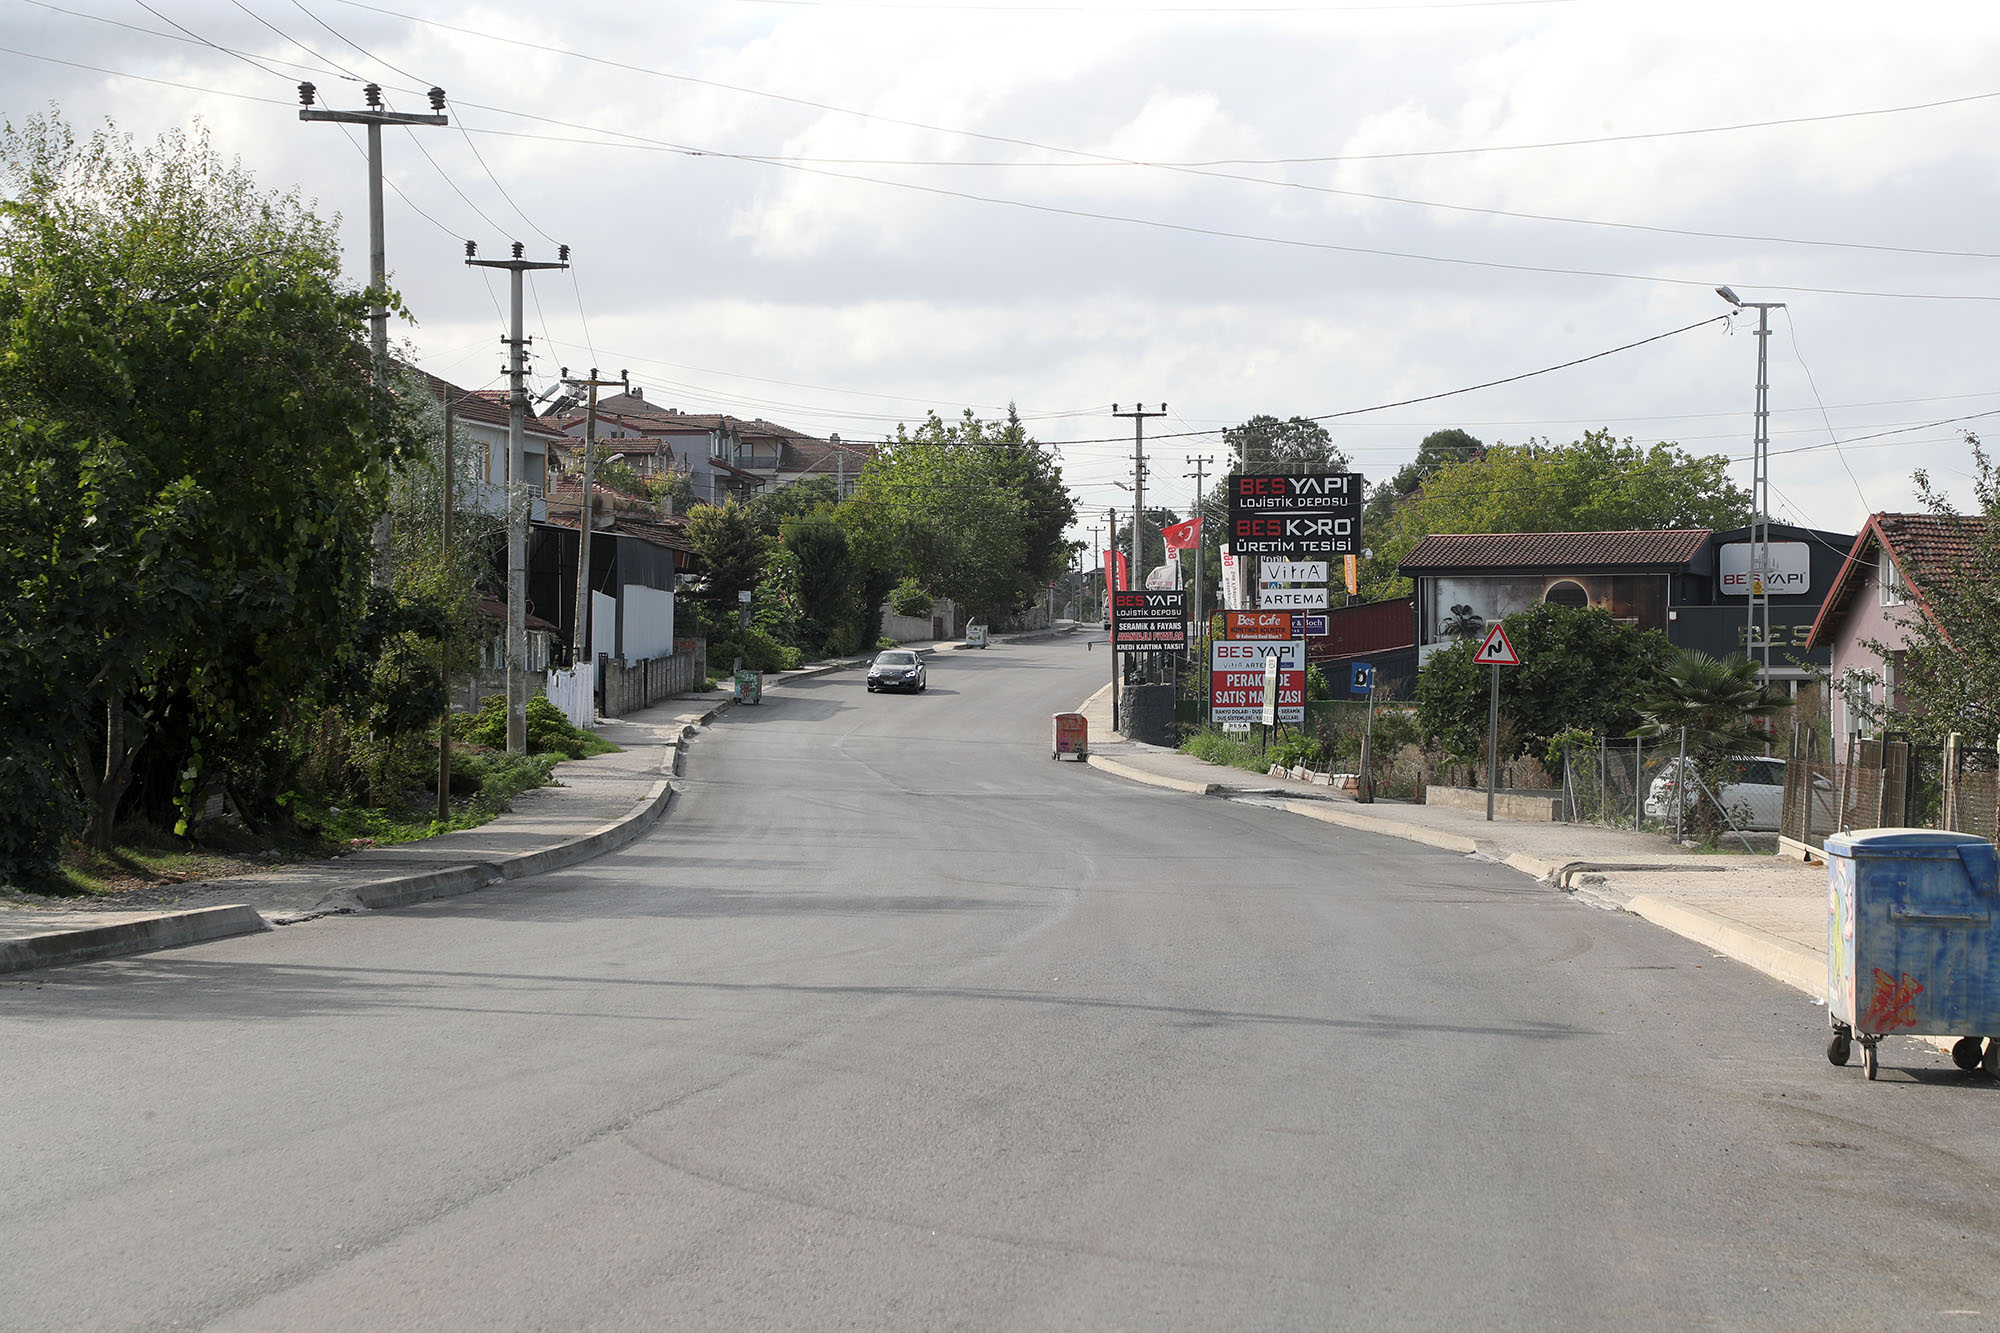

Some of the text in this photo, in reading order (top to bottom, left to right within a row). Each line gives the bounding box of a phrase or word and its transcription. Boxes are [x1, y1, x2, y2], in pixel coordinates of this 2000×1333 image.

[1239, 477, 1348, 495] BES YAPI
[1240, 495, 1348, 508] LOJİSTİK DEPOSU
[1237, 519, 1281, 536] BES
[1236, 537, 1351, 552] ÜRETİM TESİSİ
[1766, 573, 1803, 585] YAPI
[1116, 594, 1181, 606] BES YAPI
[1264, 594, 1323, 605] ARTEMA
[1116, 607, 1149, 617] LOJİSTİK
[1150, 622, 1156, 630] &
[1157, 622, 1182, 630] FAYANS
[1237, 614, 1255, 626] Bes
[1258, 614, 1281, 626] Cafe
[1217, 646, 1295, 658] BES YAPI
[1215, 690, 1247, 707] SATIŞ
